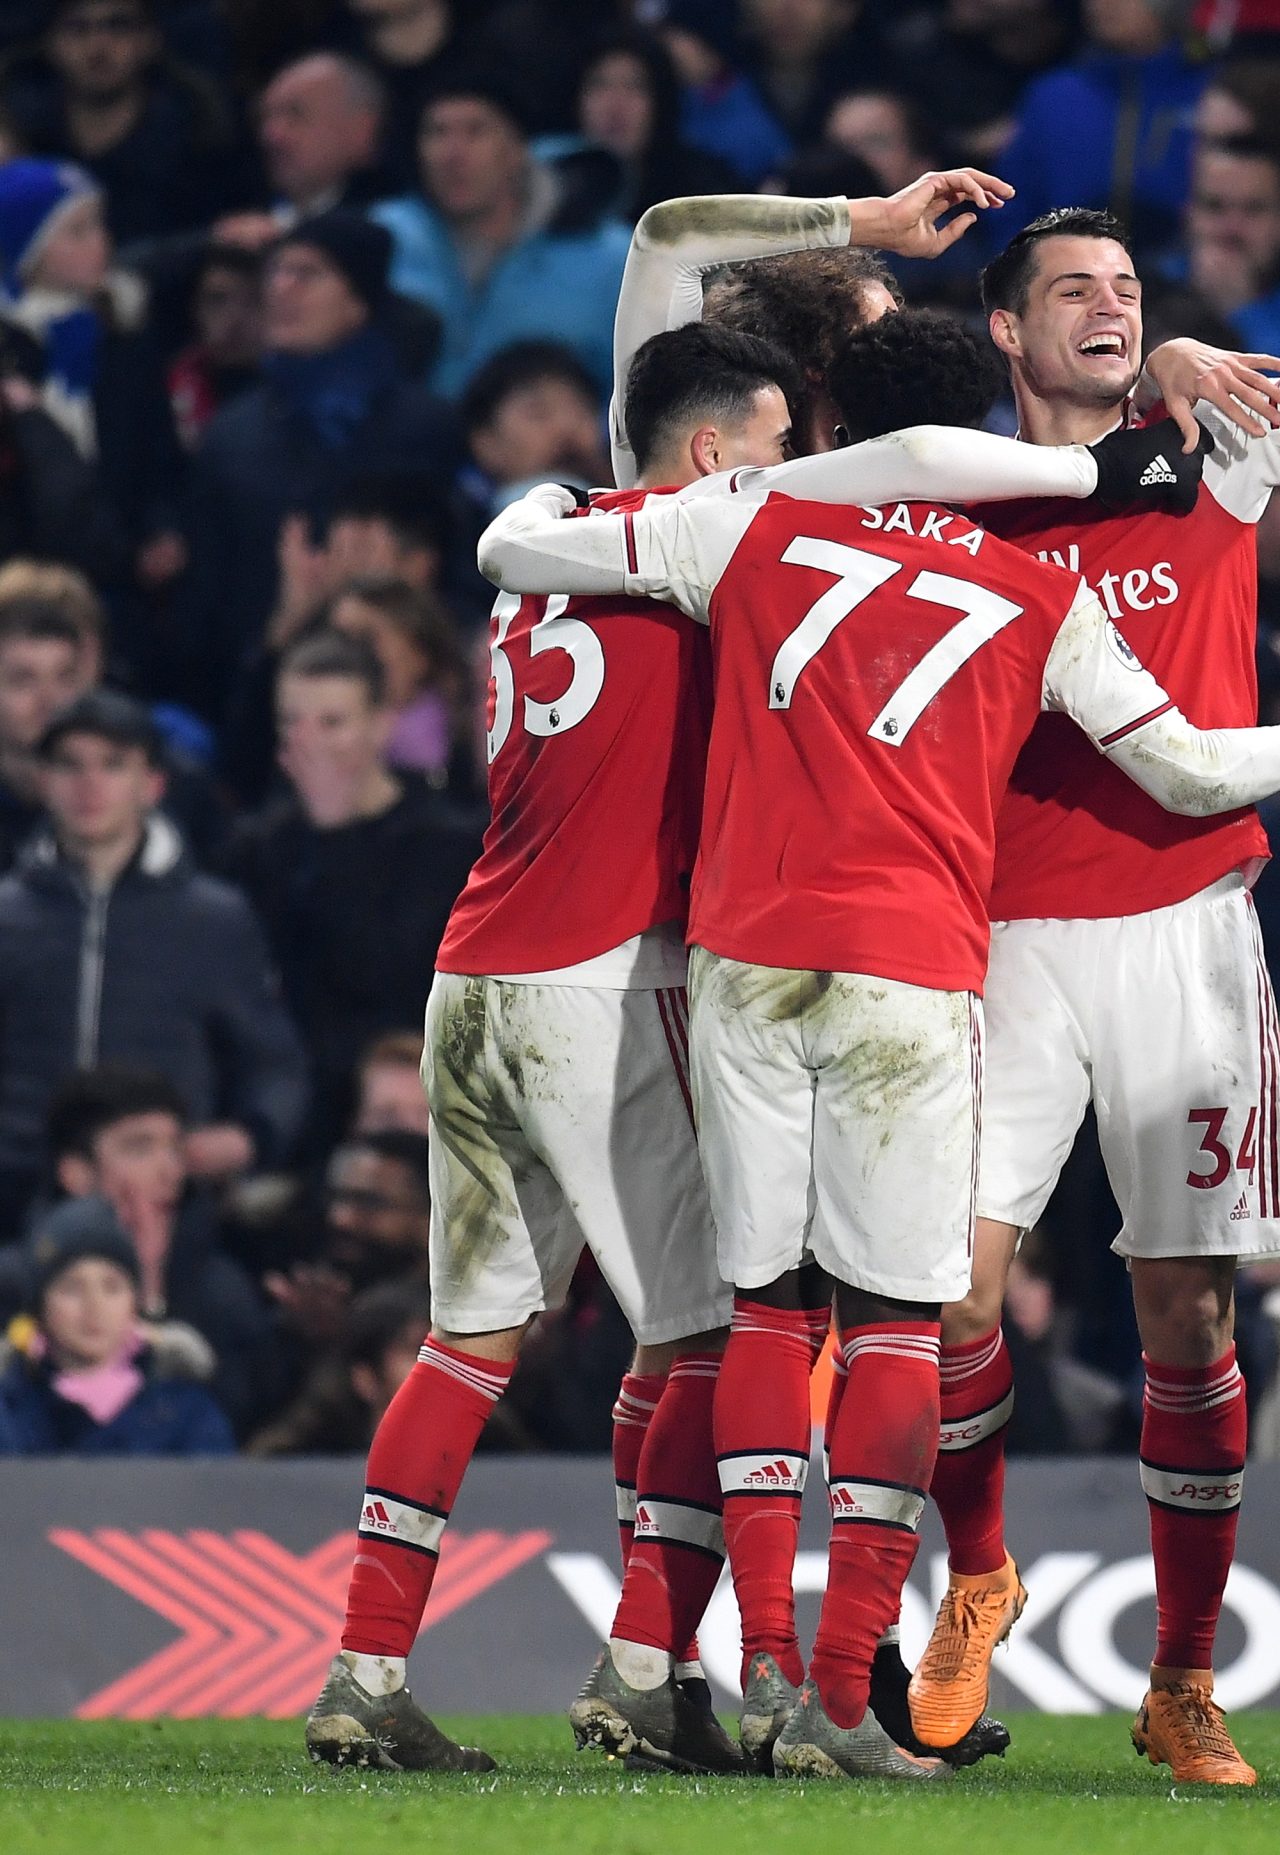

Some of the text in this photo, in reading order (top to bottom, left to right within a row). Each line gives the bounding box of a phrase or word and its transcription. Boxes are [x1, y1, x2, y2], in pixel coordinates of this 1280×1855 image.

[1139, 470, 1178, 486] adidas
[860, 502, 985, 557] SAKA
[768, 535, 1025, 748] 77
[1185, 1106, 1258, 1190] 34
